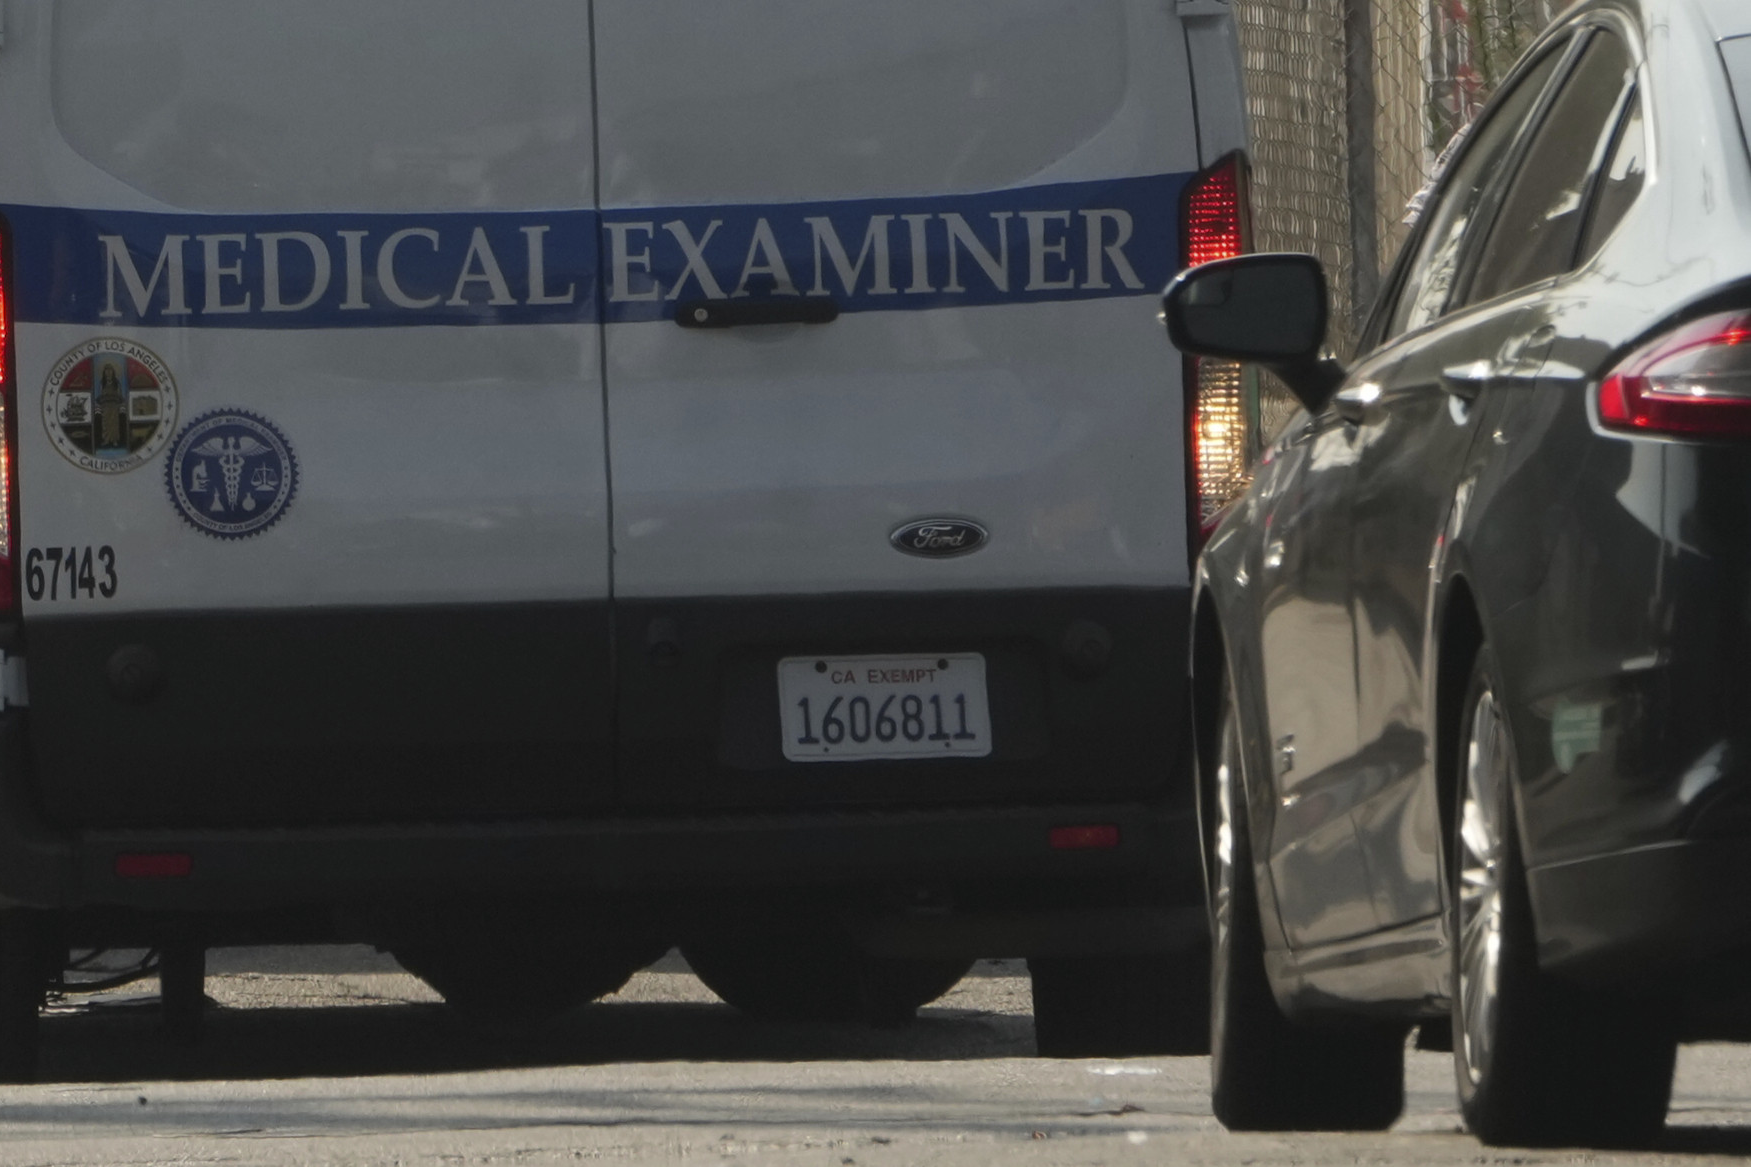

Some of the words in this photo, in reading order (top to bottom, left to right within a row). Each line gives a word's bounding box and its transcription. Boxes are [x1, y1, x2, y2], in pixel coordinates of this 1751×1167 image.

[98, 227, 575, 319] MEDICAL
[608, 207, 1146, 303] EXAMINER
[50, 350, 85, 386] COUNTY
[87, 343, 100, 353] OF
[105, 341, 125, 352] LOS
[128, 347, 168, 384] ANGELES
[79, 455, 143, 471] CALIFORNIA
[914, 526, 965, 549] Ford
[25, 545, 117, 601] 67143
[831, 671, 855, 685] CA
[868, 668, 937, 684] EXEMPT
[797, 693, 976, 745] 1606811
